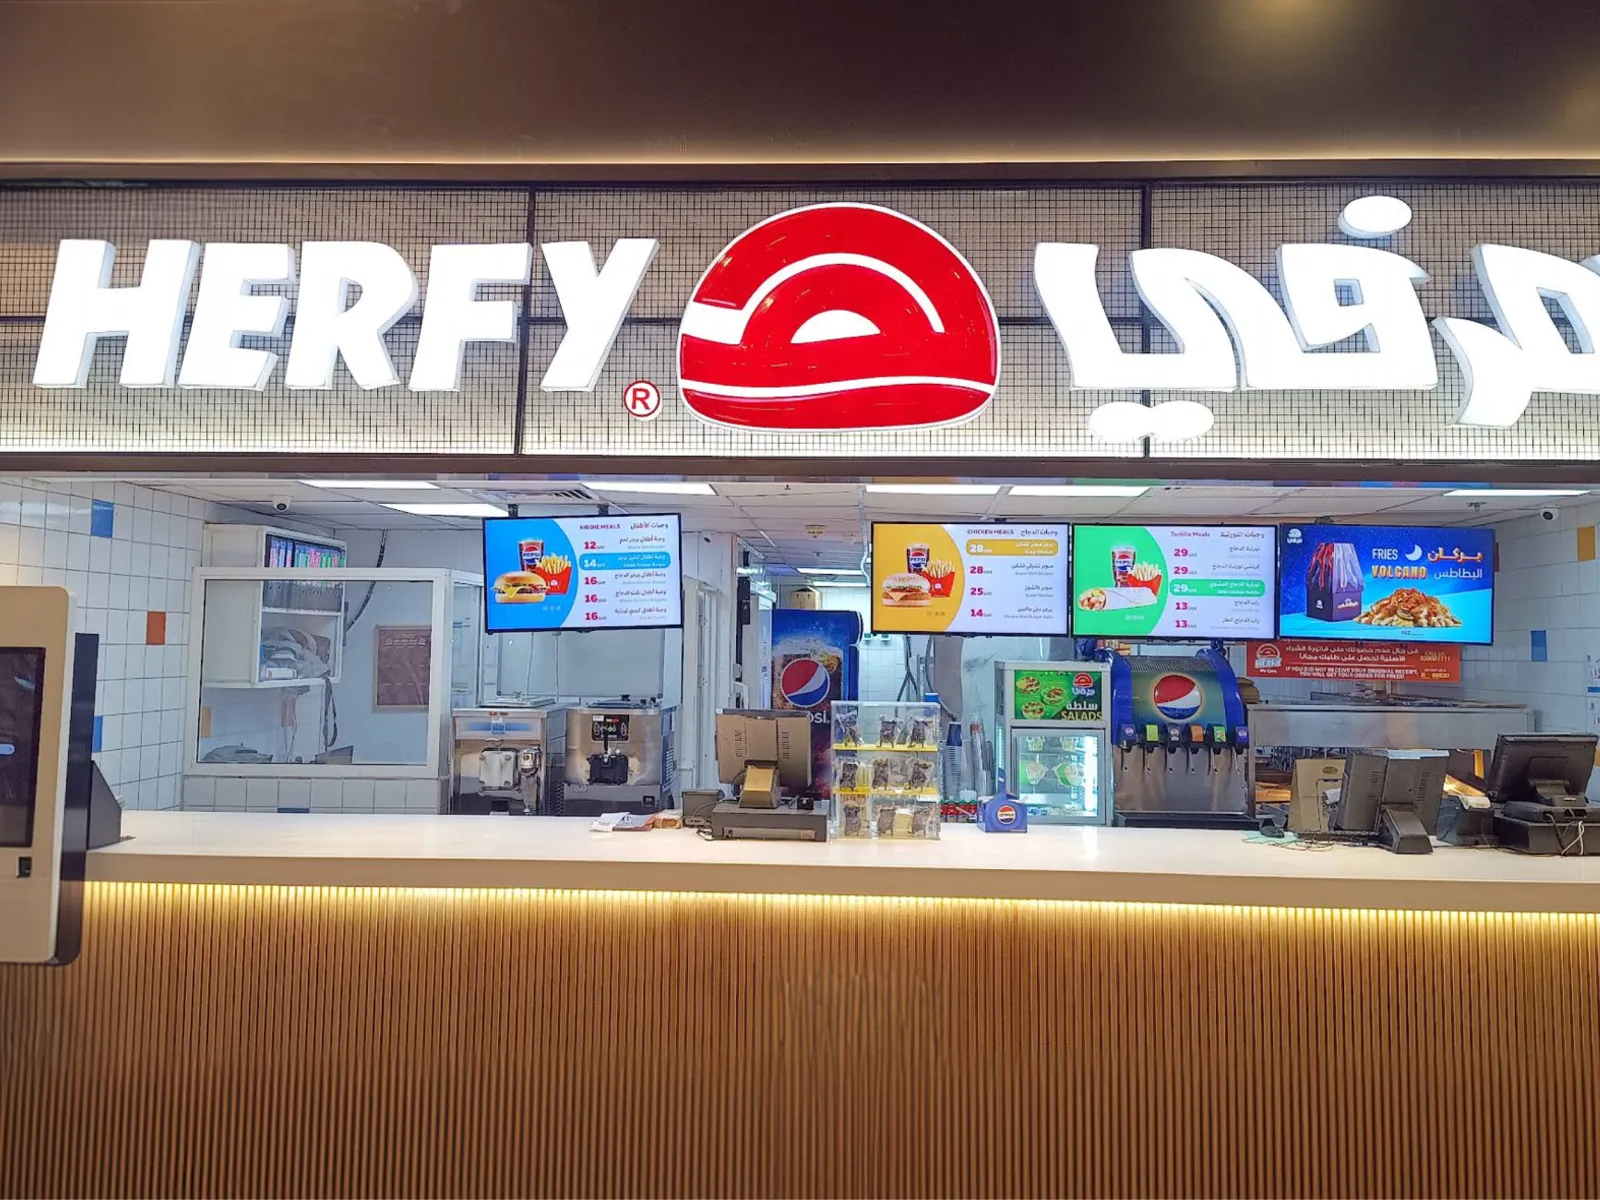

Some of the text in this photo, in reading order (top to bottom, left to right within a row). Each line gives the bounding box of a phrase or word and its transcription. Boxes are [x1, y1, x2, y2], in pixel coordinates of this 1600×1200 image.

[32, 237, 661, 391] HERFY
[584, 541, 597, 550] 12
[970, 544, 984, 553] 28
[1174, 548, 1188, 557] 29
[1372, 548, 1398, 560] FRIES
[1428, 546, 1484, 564] بركان
[584, 559, 597, 568] 14
[970, 566, 984, 574] 28
[1174, 566, 1188, 575] 29
[1372, 565, 1428, 579] VOLCANO
[1434, 568, 1483, 580] البطاطس
[584, 576, 598, 585] 16
[970, 587, 984, 596] 25
[1173, 584, 1188, 593] 29
[584, 594, 598, 603] 16
[1175, 602, 1188, 611] 13
[585, 612, 598, 620] 16
[970, 608, 983, 617] 14
[1175, 620, 1188, 628] 13
[1066, 700, 1098, 710] سلطة
[1061, 711, 1102, 720] SALADS
